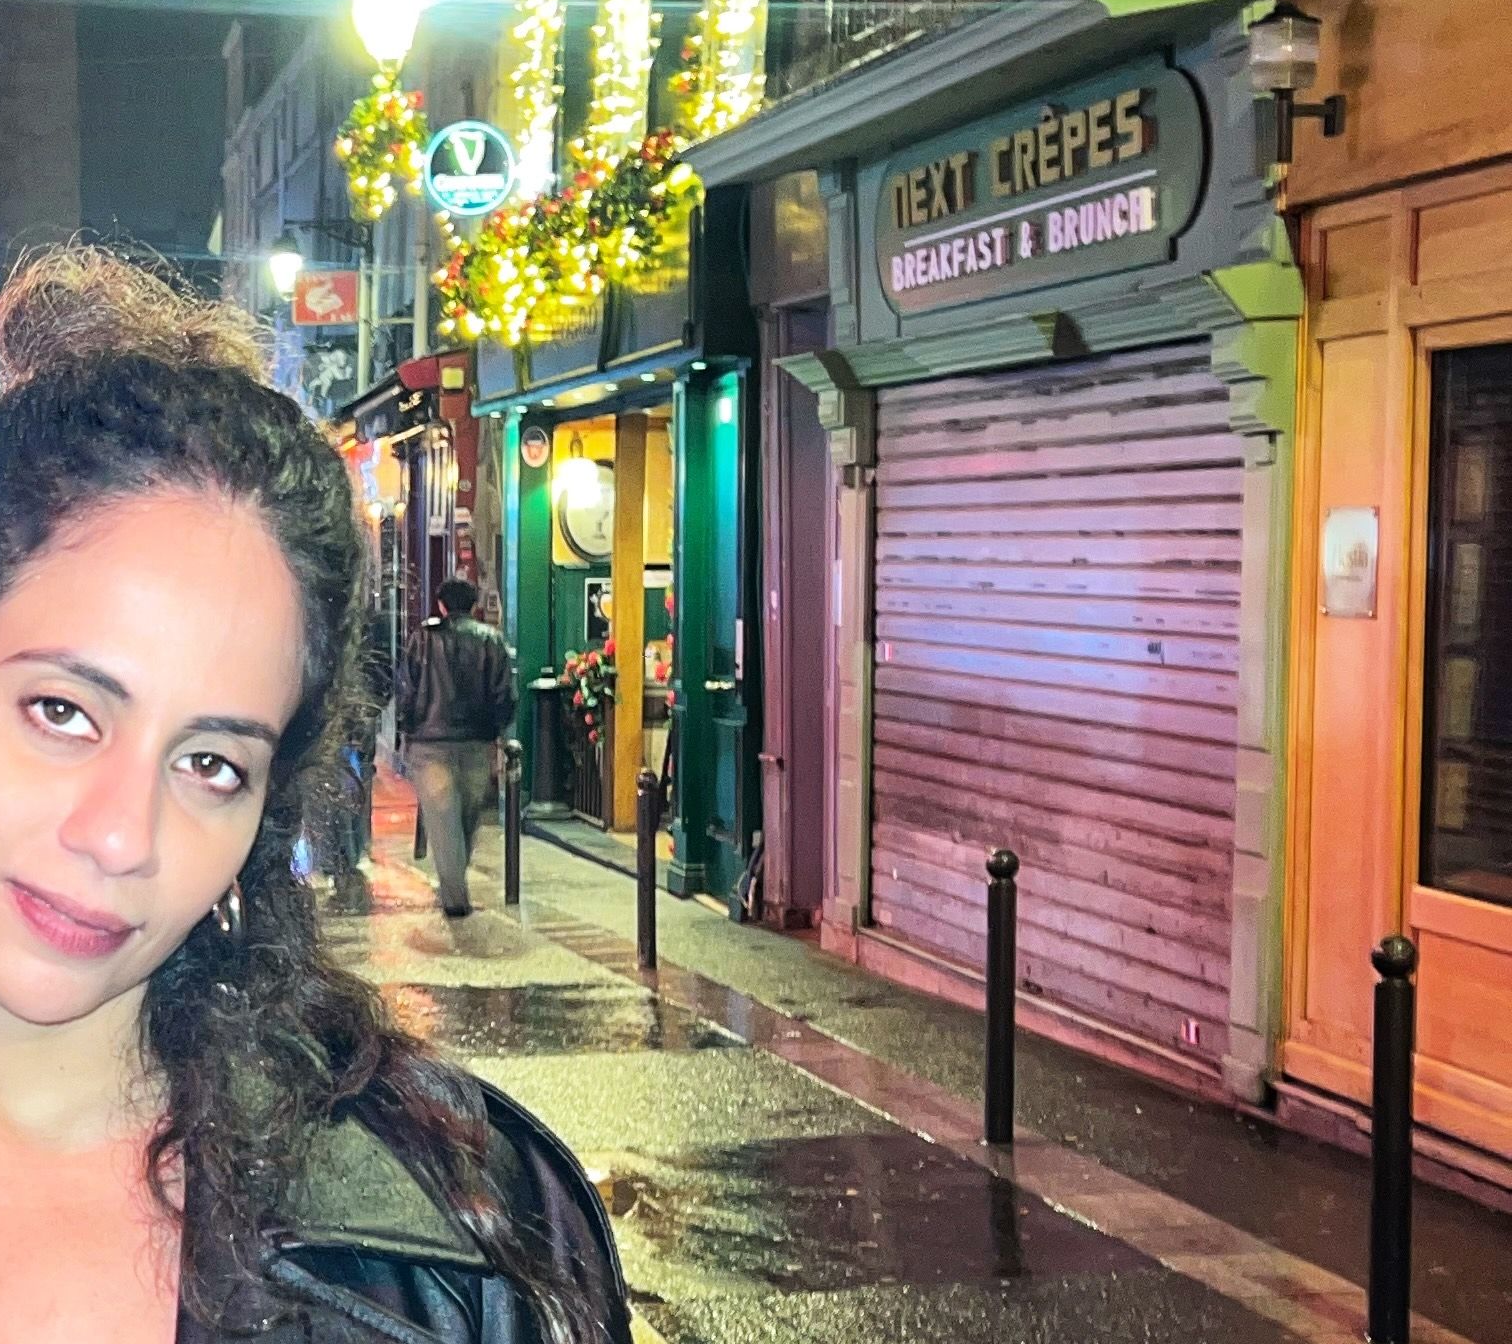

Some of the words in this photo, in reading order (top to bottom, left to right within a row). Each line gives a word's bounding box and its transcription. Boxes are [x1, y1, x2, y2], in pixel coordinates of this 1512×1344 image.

[991, 89, 1143, 198] CRÊPES
[892, 227, 1005, 293] BREAKFAST
[1019, 220, 1034, 259] &
[1047, 187, 1155, 254] BRUNCH
